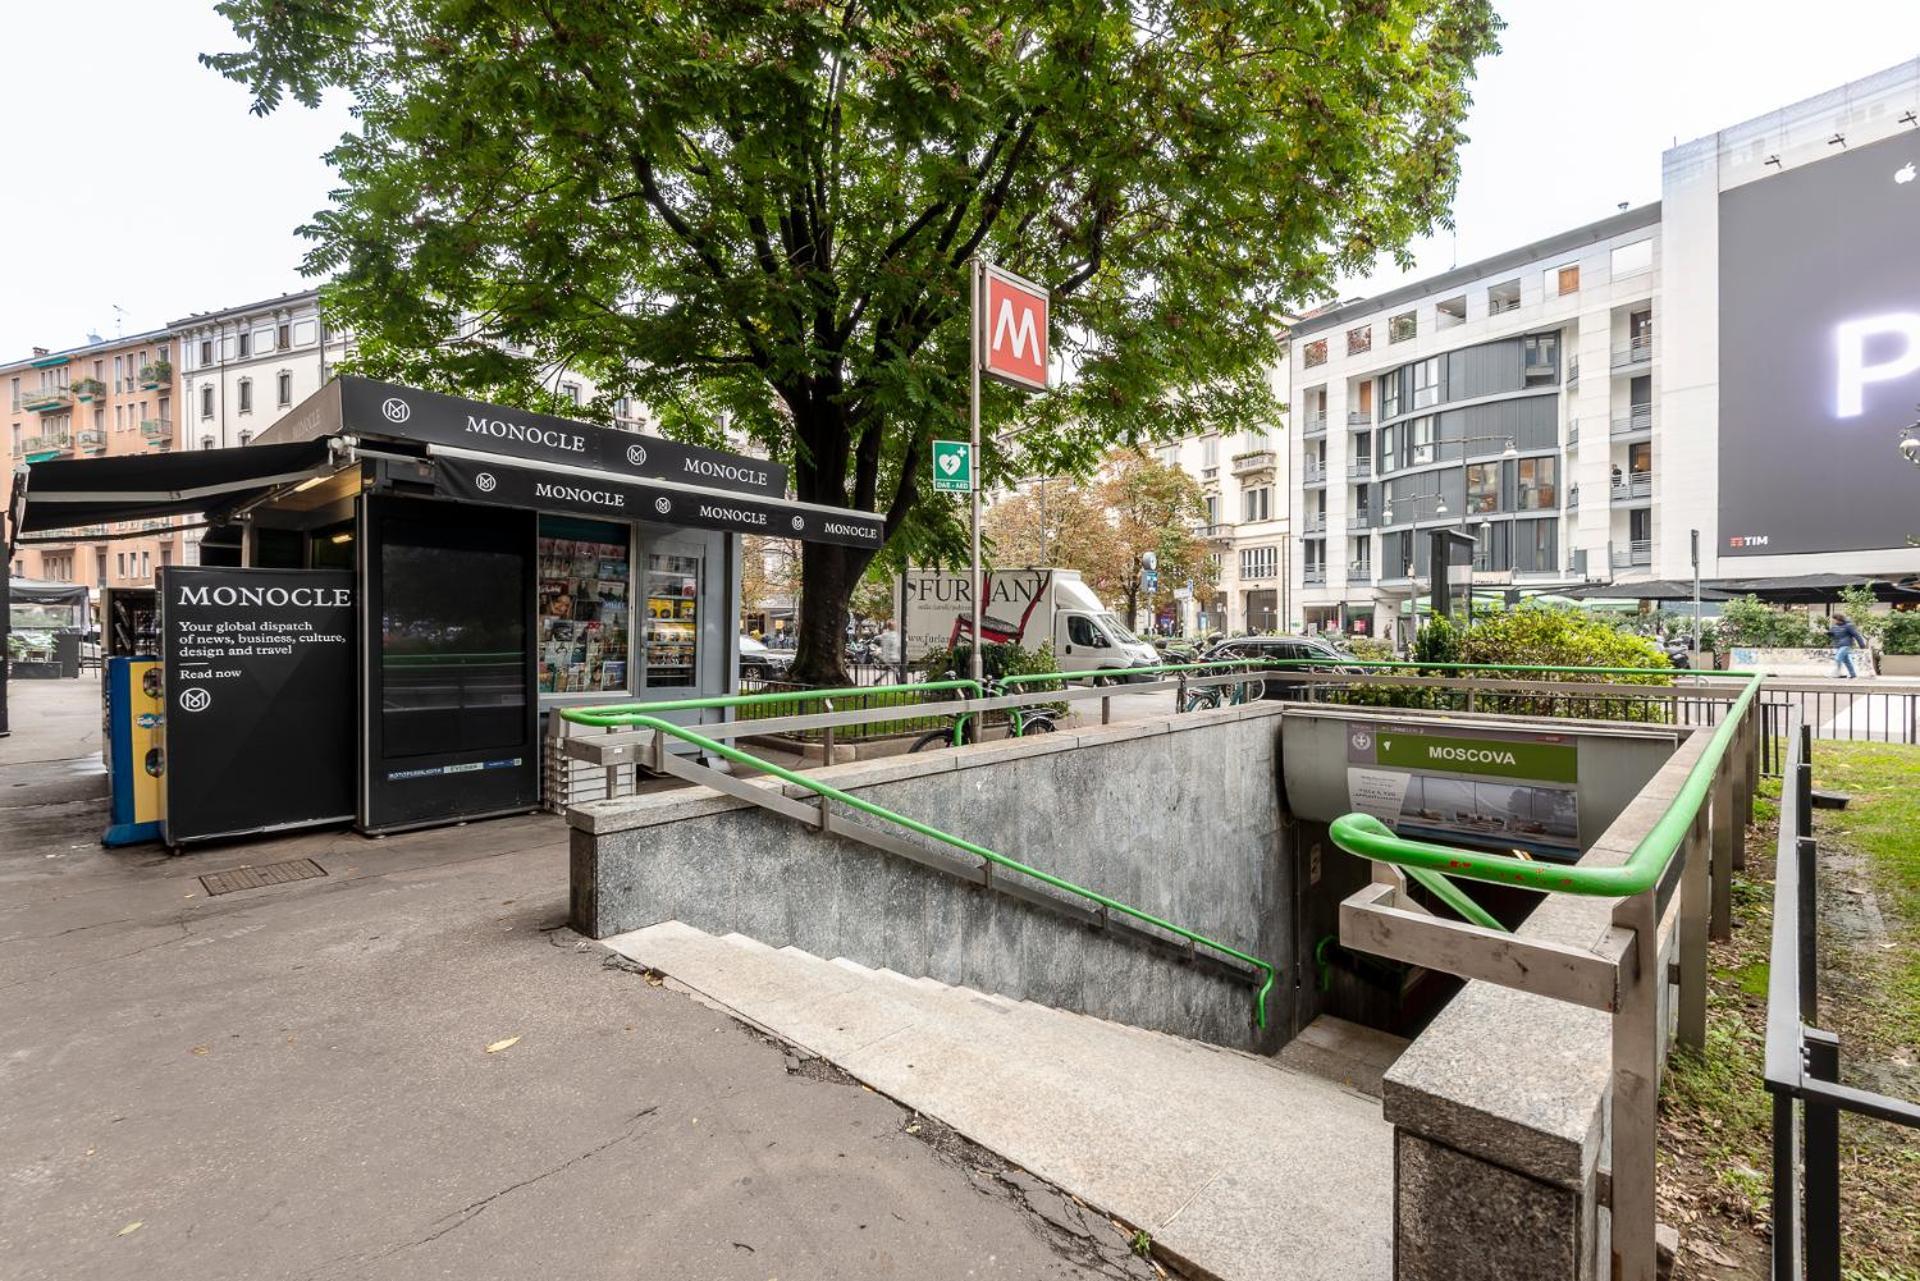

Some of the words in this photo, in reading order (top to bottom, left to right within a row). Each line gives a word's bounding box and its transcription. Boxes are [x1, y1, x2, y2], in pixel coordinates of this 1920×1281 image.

[992, 298, 1042, 367] M
[465, 415, 586, 452] MONOCLE
[683, 457, 768, 486] MONOCLE
[535, 483, 625, 507] MONOCLE
[699, 505, 767, 525] MONOCLE
[824, 522, 878, 539] MONOCLE
[1744, 535, 1769, 546] TIM
[177, 586, 352, 607] MONOCLE
[178, 621, 213, 632] Your
[215, 621, 256, 634] global
[259, 621, 313, 633] dispatch
[179, 634, 195, 645] of
[197, 635, 235, 645] news,
[238, 633, 296, 644] business,
[298, 633, 346, 643] culture,
[179, 646, 224, 658] design
[228, 646, 253, 656] and
[256, 645, 293, 655] travel
[179, 669, 212, 679] Read
[215, 669, 242, 679] now
[1429, 746, 1516, 766] MOSCOVA
